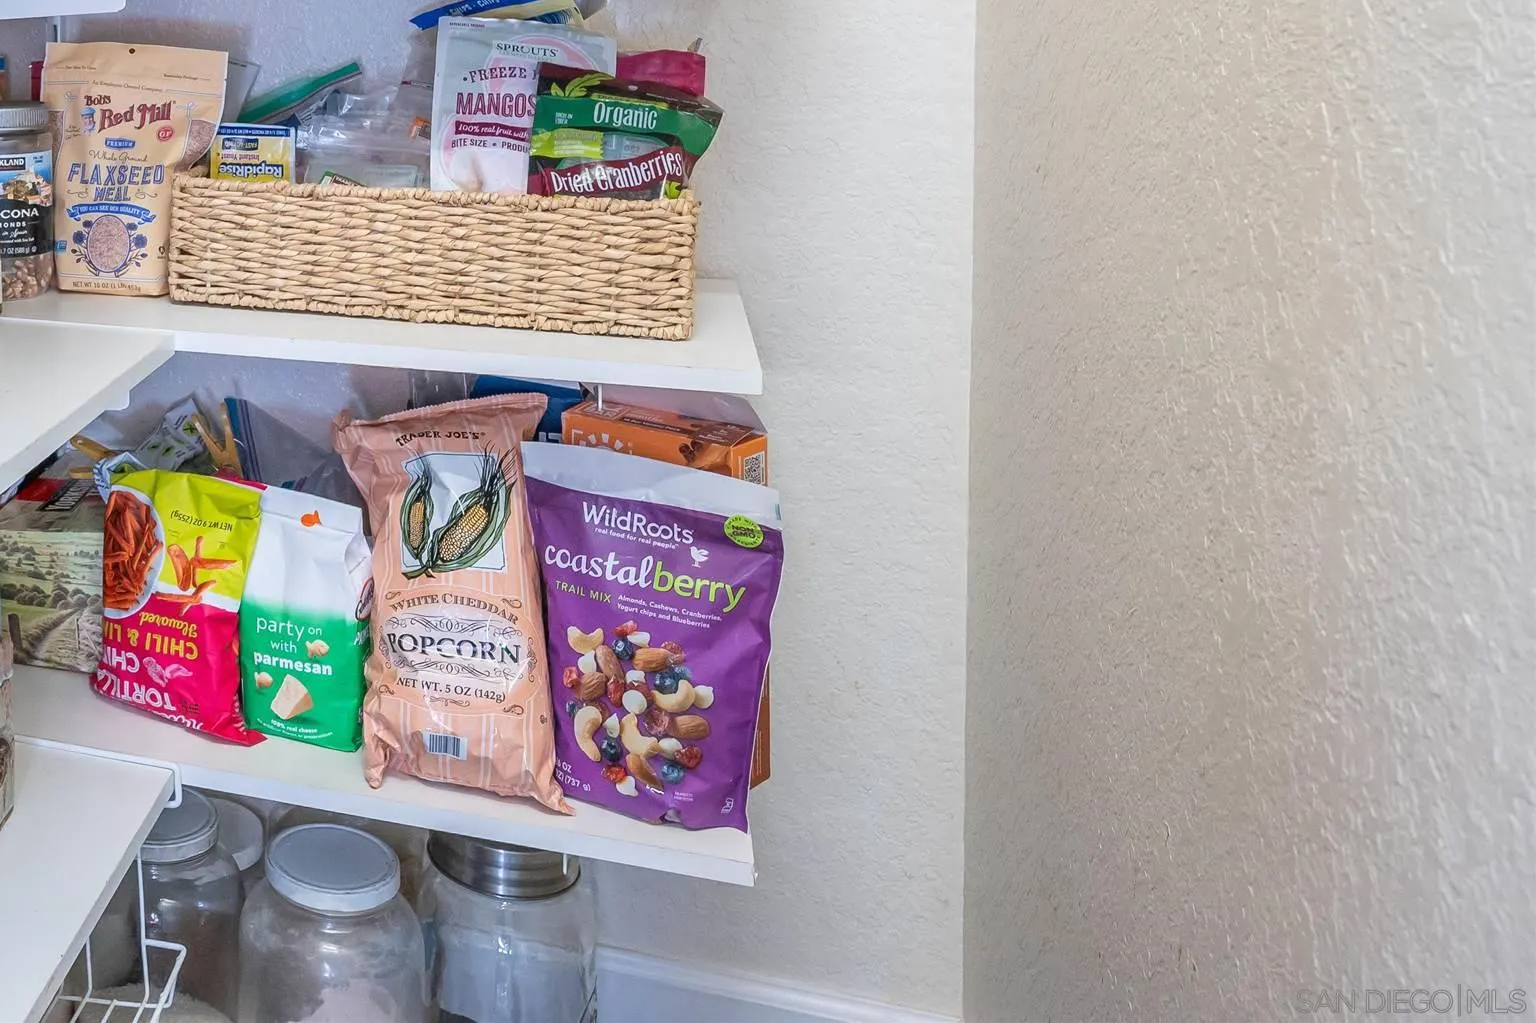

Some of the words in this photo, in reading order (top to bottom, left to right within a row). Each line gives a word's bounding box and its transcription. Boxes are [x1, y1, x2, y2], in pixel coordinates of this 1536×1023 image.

[496, 43, 558, 57] SPROUTS
[469, 67, 526, 83] FREEZE
[84, 94, 111, 106] Bob's
[98, 104, 135, 133] Red
[134, 101, 172, 130] Mill
[594, 102, 658, 129] Organic
[459, 124, 479, 133] 100%
[496, 126, 512, 135] fruit
[452, 138, 467, 148] BITE
[470, 138, 488, 147] SIZE
[89, 150, 117, 161] Whole
[119, 152, 148, 162] Ground
[67, 163, 164, 185] FLAXSEED
[219, 161, 283, 178] RapidRise
[551, 168, 594, 193] Dried
[596, 150, 683, 191] Cranberries
[94, 186, 131, 202] MEAL
[395, 430, 443, 448] TRADER
[445, 431, 481, 441] JOE'S
[170, 509, 193, 525] (255g)
[193, 517, 202, 527] OZ
[583, 501, 693, 545] WildRoots
[219, 522, 233, 532] NET
[731, 525, 755, 533] NON
[732, 531, 755, 539] GMO
[595, 527, 608, 535] real
[610, 530, 625, 540] food
[627, 534, 637, 542] for
[638, 536, 651, 546] real
[653, 541, 676, 550] people
[555, 580, 585, 597] TRAIL
[590, 590, 612, 603] MIX
[389, 593, 440, 614] WHITE
[441, 592, 519, 626] CHEDDAR
[617, 603, 639, 615] Yogurt
[640, 608, 657, 618] chips
[658, 612, 671, 621] and
[672, 615, 710, 628] Blueberries
[618, 594, 648, 607] Almonds,
[649, 601, 680, 614] Cashews,
[681, 608, 722, 621] Cranberries,
[138, 611, 198, 638] Flavored
[256, 617, 305, 642] party
[307, 626, 323, 635] on
[127, 627, 139, 646] &
[144, 632, 199, 659] CHILI
[270, 639, 297, 653] with
[386, 632, 522, 666] POPCORN
[253, 651, 333, 676] parmesan
[396, 677, 418, 689] NET
[420, 680, 442, 694] WT.
[445, 684, 452, 695] 5
[454, 685, 472, 697] OZ
[474, 687, 506, 704] (142g)
[270, 719, 285, 729] 100%
[286, 724, 298, 732] real
[561, 762, 572, 773] OZ
[564, 775, 580, 787] (737
